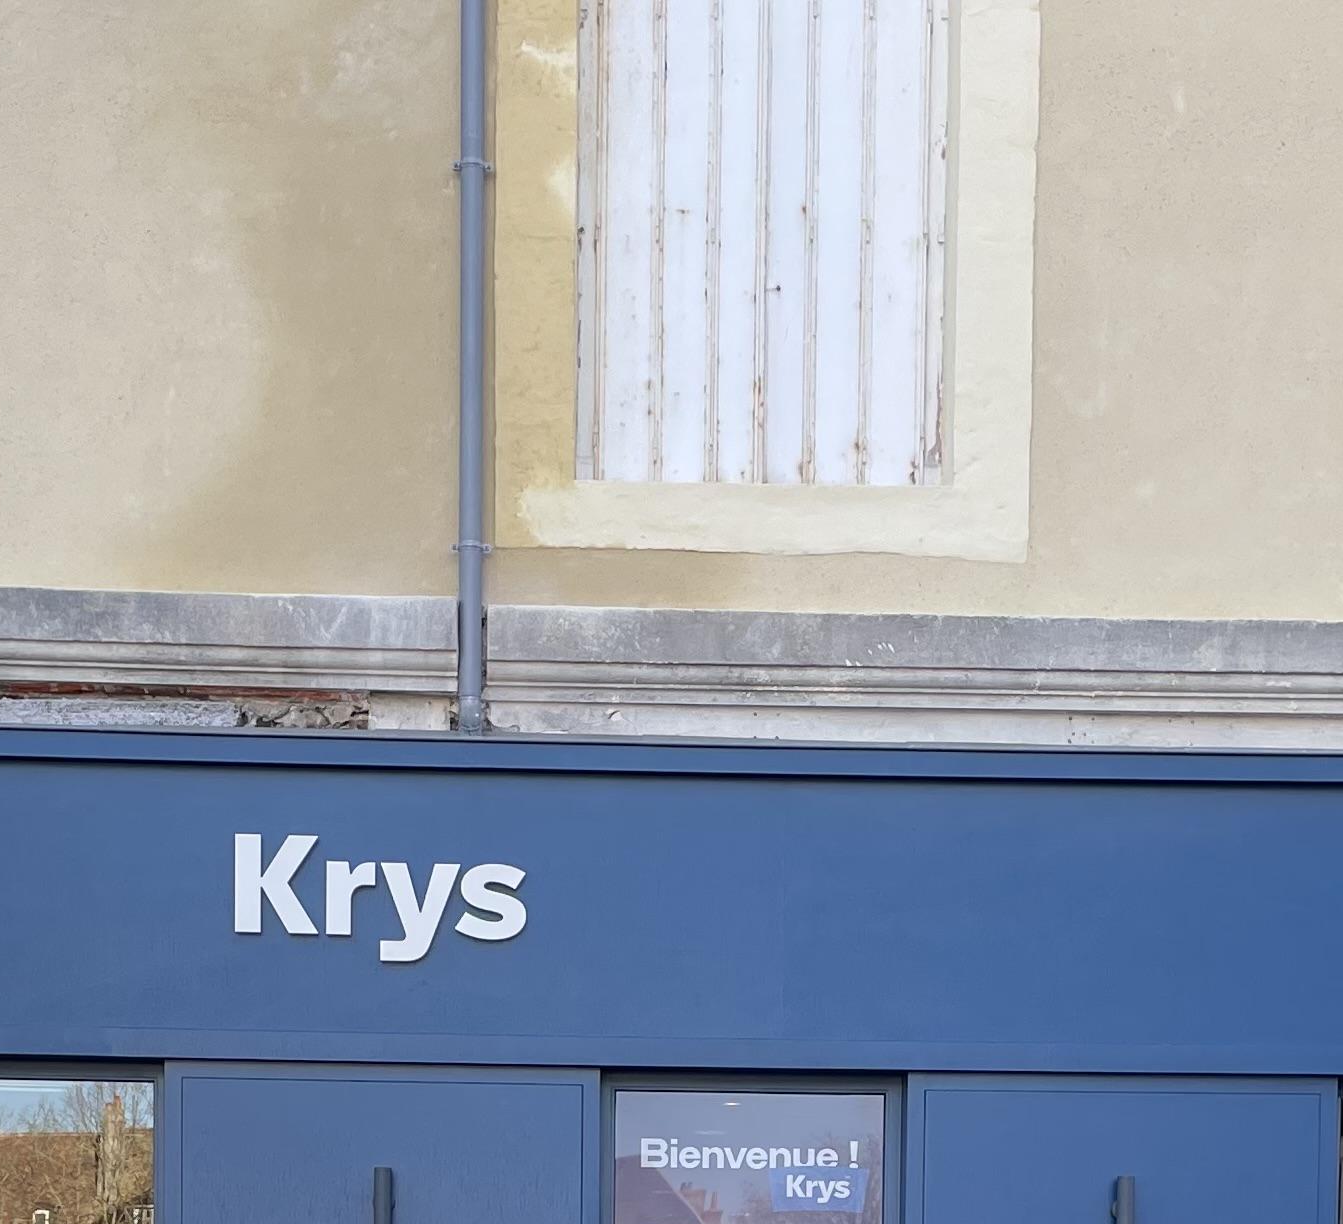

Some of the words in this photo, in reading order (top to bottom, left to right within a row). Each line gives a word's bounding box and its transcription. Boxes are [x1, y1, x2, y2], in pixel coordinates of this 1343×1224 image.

[234, 833, 527, 963] Krys
[640, 1137, 839, 1169] Bienvenue
[849, 1140, 859, 1169] !
[786, 1174, 851, 1204] Krys
